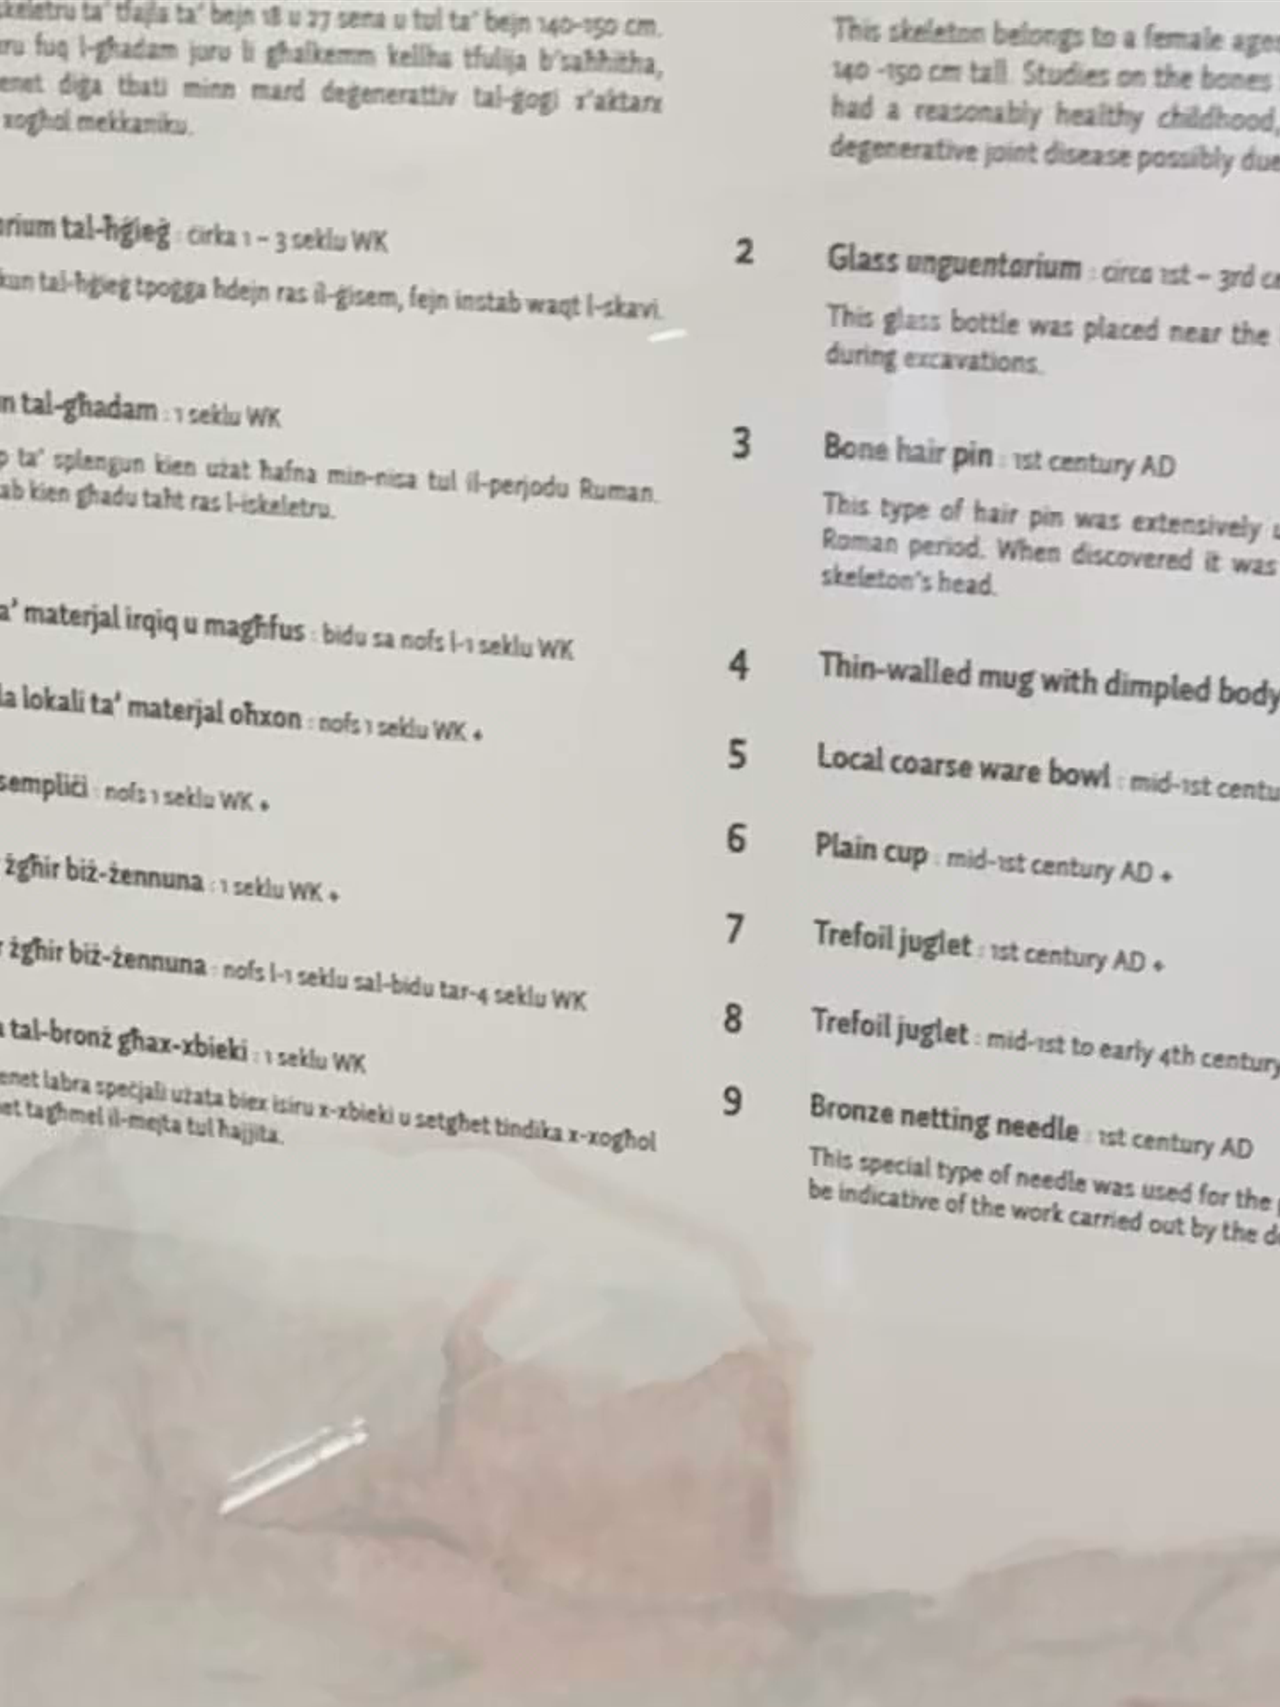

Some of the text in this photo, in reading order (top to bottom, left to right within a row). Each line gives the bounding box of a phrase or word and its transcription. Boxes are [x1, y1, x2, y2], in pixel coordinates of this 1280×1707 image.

[735, 237, 754, 266] 2
[827, 242, 900, 274] Glass
[1217, 263, 1256, 293] 3rd
[732, 428, 1177, 482] 3 Bone hair pin 1st century AD
[823, 490, 871, 517] This
[880, 497, 931, 525] type
[939, 497, 965, 522] of
[973, 499, 1020, 525] hair
[1029, 507, 1064, 532] pin
[1074, 512, 1121, 531] was
[1131, 512, 1263, 545] extensively
[821, 565, 997, 596] skeleton’s head.
[822, 528, 899, 554] Roman
[908, 534, 986, 561] period.
[996, 537, 1061, 563] When
[1071, 541, 1194, 572] discovered
[1204, 550, 1222, 574] it
[1231, 557, 1277, 577] was
[23, 603, 121, 635] materjal
[125, 606, 179, 641] irqiq
[183, 616, 198, 635] u
[322, 621, 368, 648] bidu
[372, 632, 396, 649] sa
[400, 627, 445, 653] nofs
[478, 633, 534, 659] seklu
[537, 637, 574, 661] WK
[728, 648, 750, 681] 4
[819, 650, 972, 687] Thin-walled
[978, 669, 1037, 699] mug
[1040, 667, 1099, 695] with
[1104, 668, 1212, 707] dimpled
[22, 684, 85, 713] lokali
[89, 690, 122, 716] ta’
[127, 697, 225, 730] materjal
[318, 711, 362, 736] nofs
[377, 715, 429, 740] seklu
[432, 720, 467, 742] WK
[728, 737, 747, 770] 5
[817, 741, 885, 772] Local
[889, 754, 974, 779] coarse
[979, 761, 1042, 784] ware
[1048, 757, 1111, 789] bowl
[1129, 770, 1213, 797] mid-1st
[726, 822, 1154, 886] 6 Plain cup mid-1st century AD
[233, 875, 285, 900] seklu
[288, 881, 323, 903] WK
[726, 912, 1146, 975] 7 Trefoil juglet 1st century AD
[277, 1046, 328, 1071] seklu
[332, 1052, 366, 1074] WK
[723, 1002, 743, 1034] 8
[811, 1006, 892, 1039] Trefoil
[895, 1015, 969, 1049] juglet
[987, 1028, 1066, 1055] mid-1st
[1070, 1036, 1095, 1057] to
[1098, 1038, 1155, 1068] early
[1158, 1043, 1196, 1067] 4th
[722, 1085, 1254, 1161] 9 Bronze netting needle 1st century AD
[809, 1145, 854, 1171] This
[859, 1155, 932, 1178] special
[936, 1160, 984, 1187] type
[988, 1162, 1013, 1185] of
[1015, 1169, 1087, 1194] needle
[1092, 1179, 1136, 1198] was
[1141, 1181, 1194, 1205] used
[1198, 1182, 1231, 1207] for
[1235, 1187, 1273, 1212] the
[808, 1177, 833, 1201] be
[838, 1182, 941, 1212] indicative
[945, 1192, 967, 1214] of
[970, 1194, 1006, 1218] the
[1010, 1201, 1064, 1223] work
[1068, 1210, 1144, 1233] carried
[1148, 1216, 1186, 1237] out
[1190, 1215, 1218, 1245] by
[1221, 1220, 1259, 1244] the
